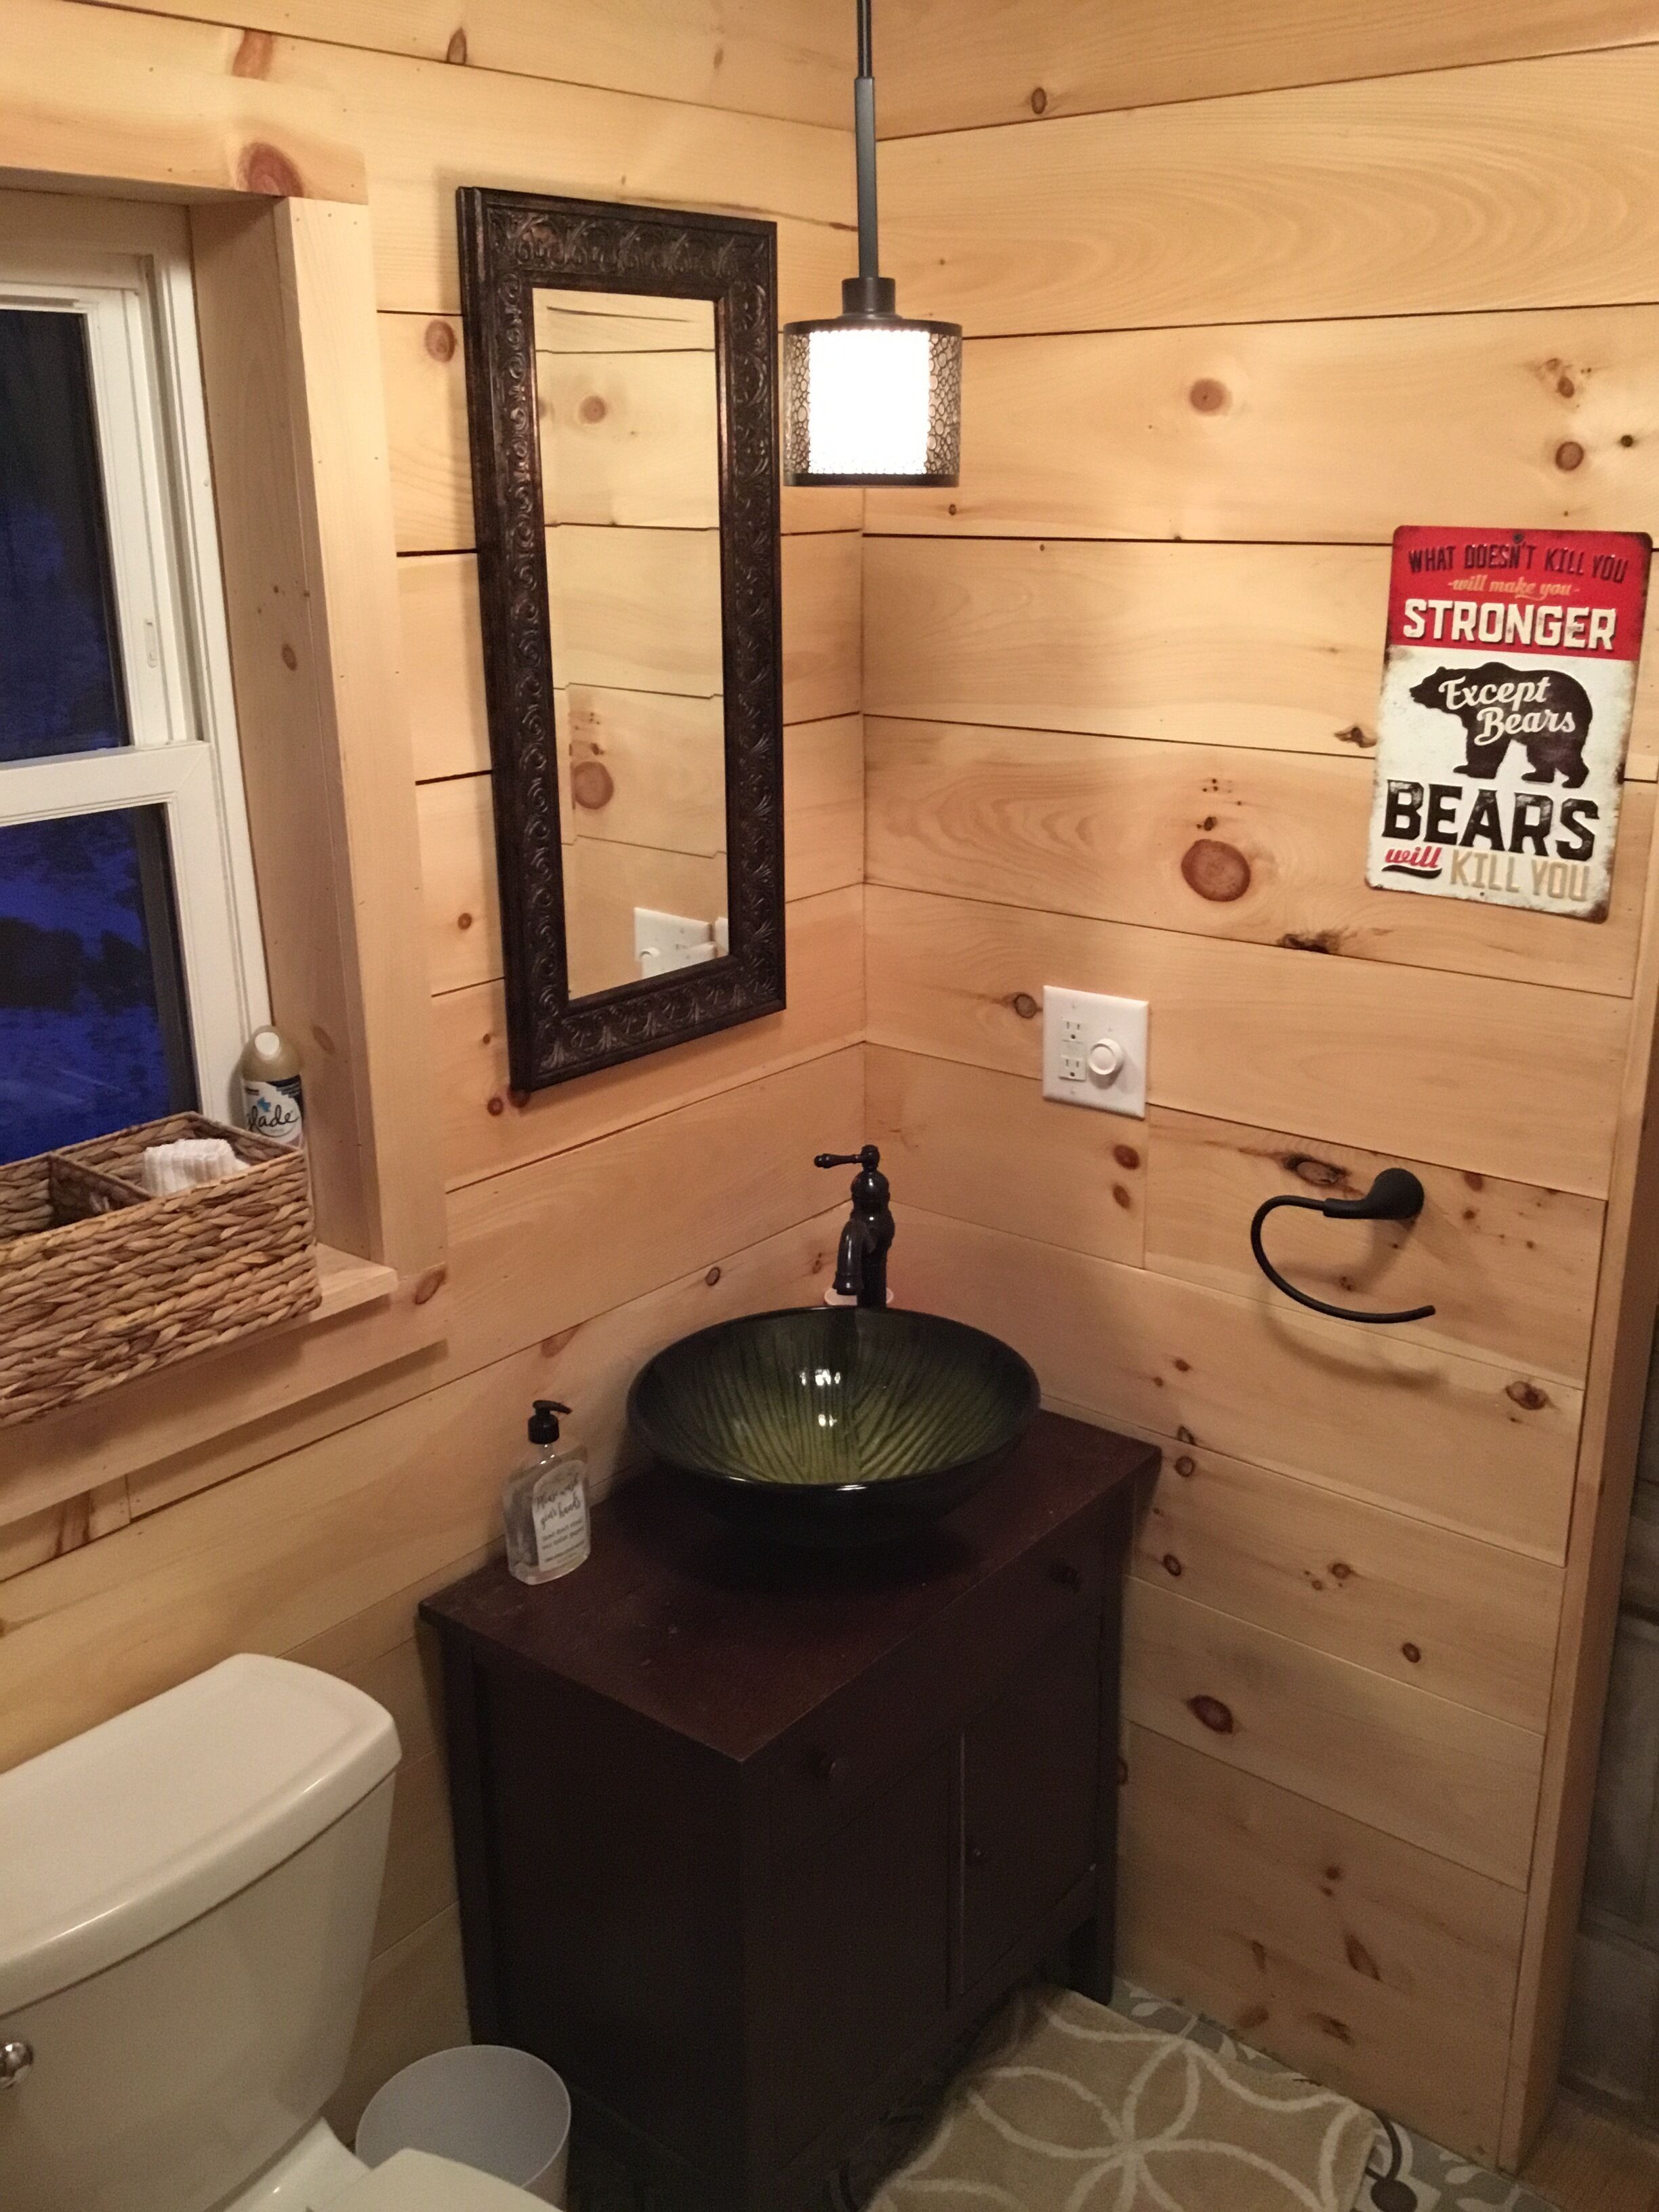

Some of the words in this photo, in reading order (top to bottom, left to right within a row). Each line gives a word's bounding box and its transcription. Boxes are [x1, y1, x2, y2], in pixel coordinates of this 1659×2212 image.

[1408, 546, 1455, 573] WHAT
[1464, 541, 1537, 570] DOESN'T
[1544, 547, 1585, 575] KILL
[1593, 554, 1629, 583] YOU
[1490, 577, 1536, 594] make
[1403, 598, 1616, 651] STRONGER
[1438, 676, 1551, 711] Except
[1473, 707, 1576, 746] Bears
[1381, 779, 1600, 861] BEARS
[1385, 845, 1443, 869] will
[1450, 850, 1521, 893] KILL
[1531, 858, 1591, 902] YOU
